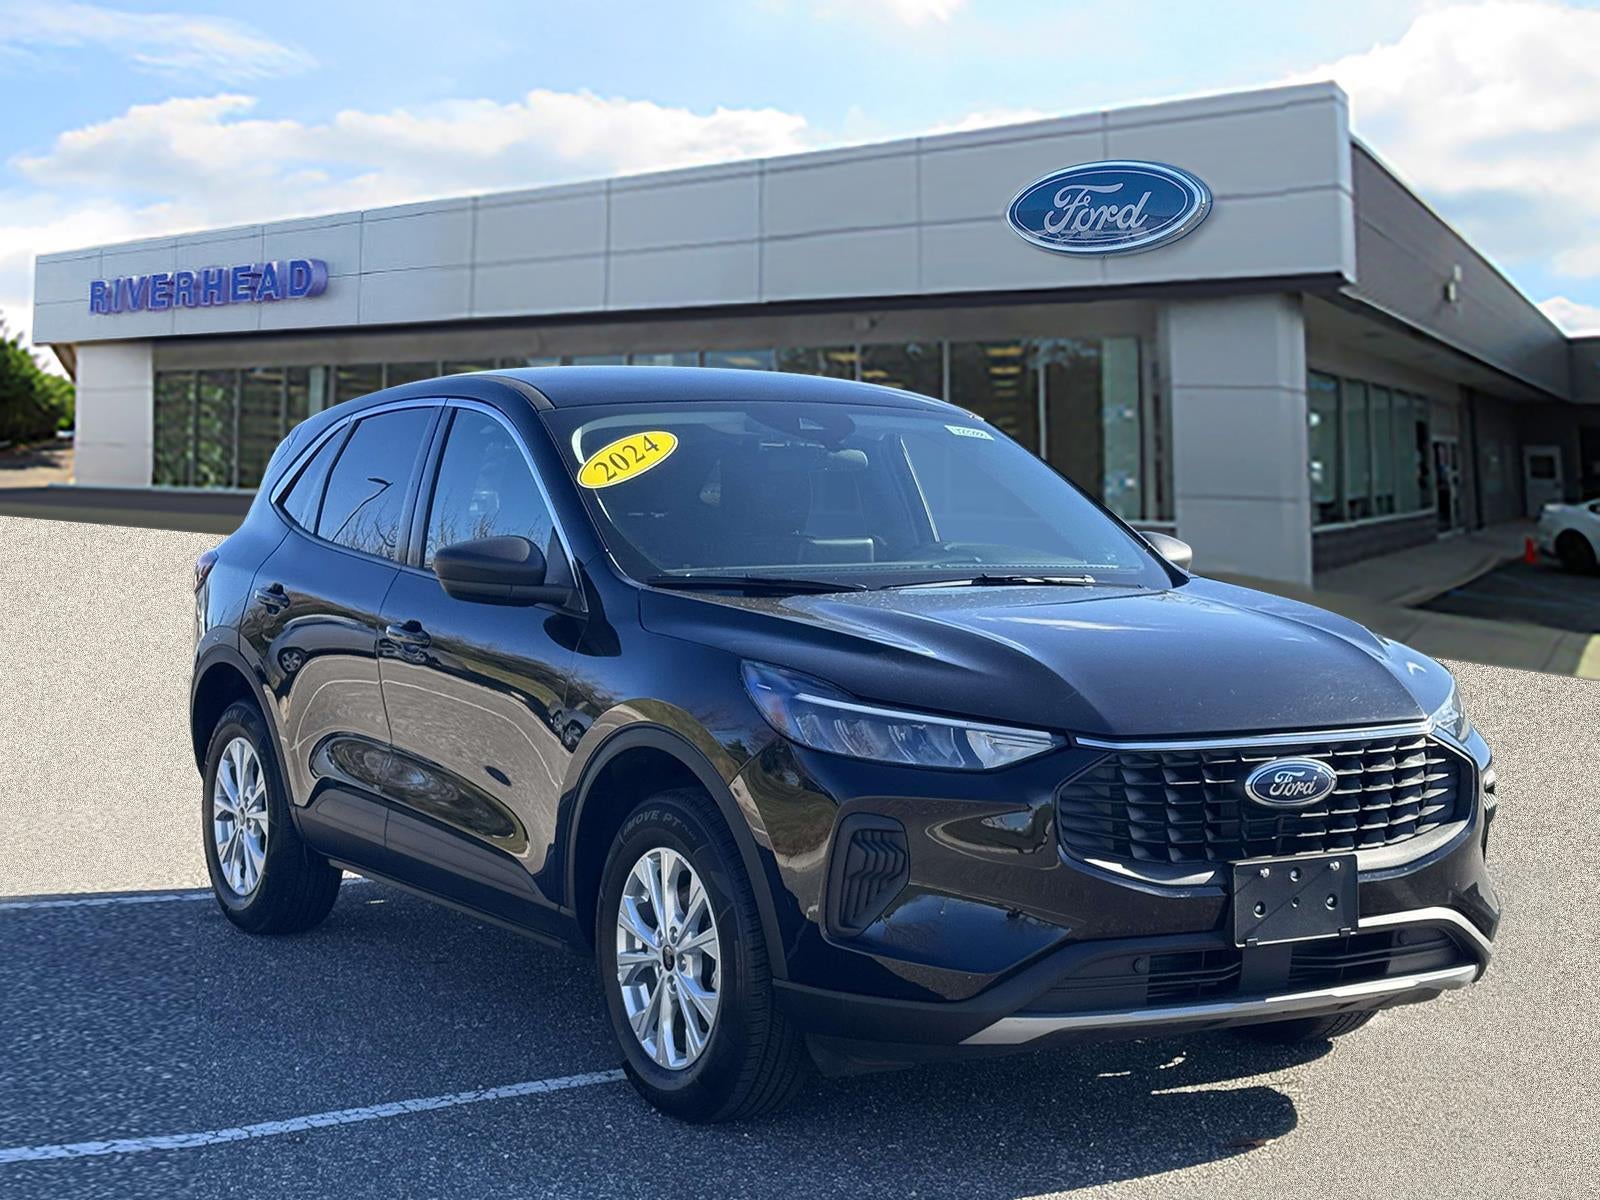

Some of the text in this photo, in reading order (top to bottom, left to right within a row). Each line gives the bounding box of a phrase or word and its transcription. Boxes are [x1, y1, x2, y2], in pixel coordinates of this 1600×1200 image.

[1043, 182, 1152, 234] Ford
[89, 259, 325, 315] RIVERHEAD
[593, 435, 660, 482] 2024
[1269, 770, 1318, 797] Ford
